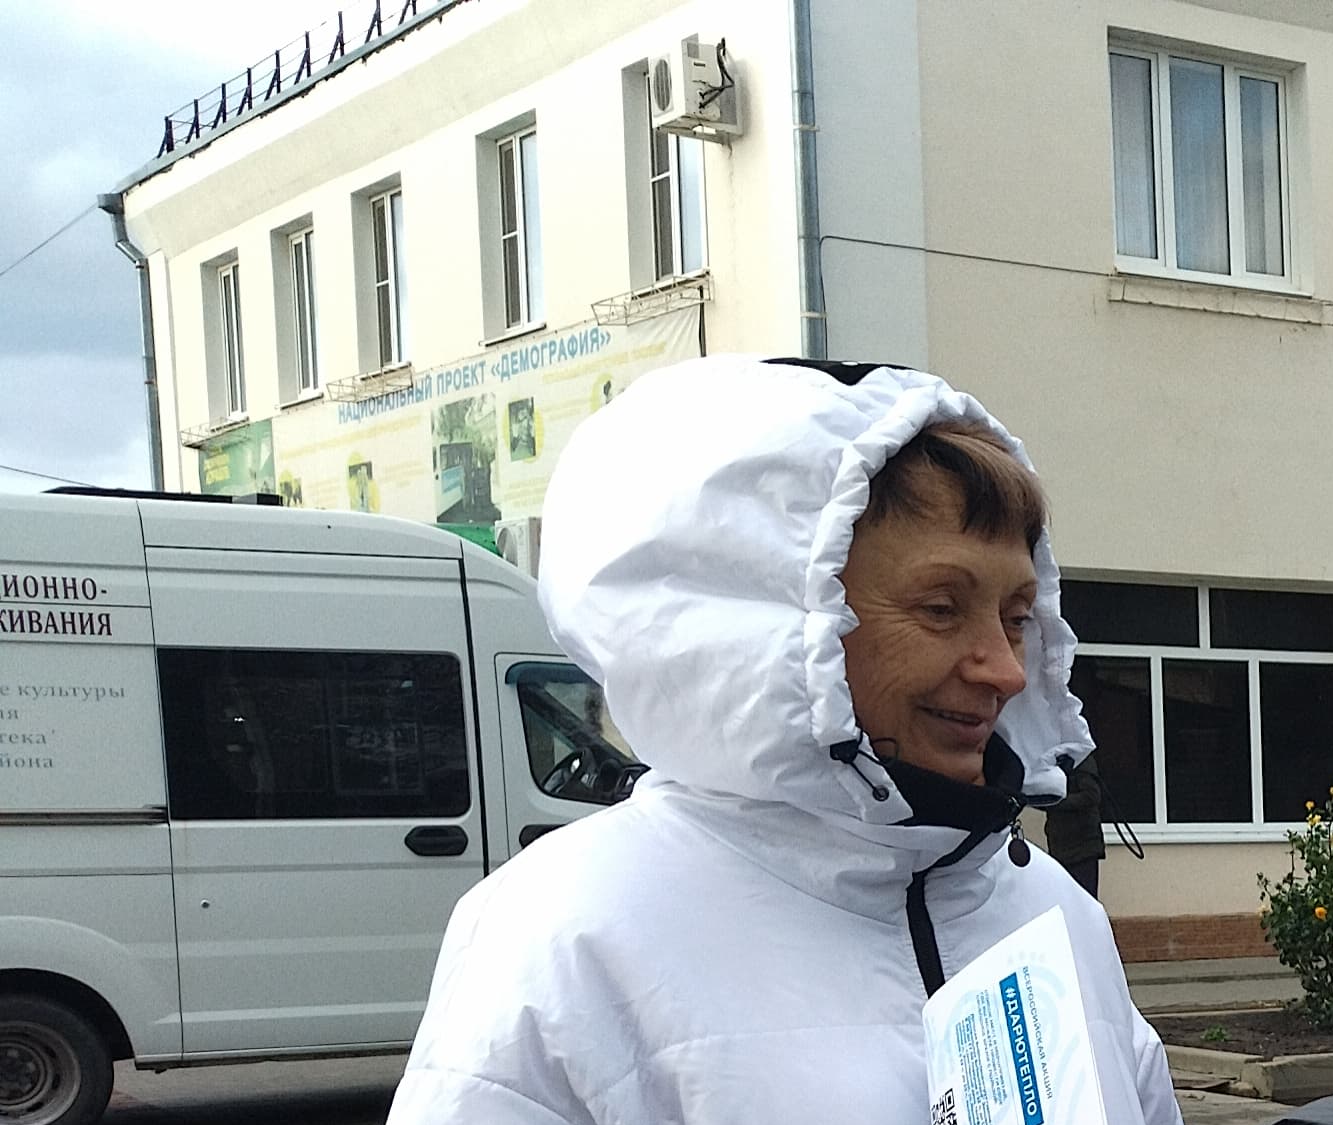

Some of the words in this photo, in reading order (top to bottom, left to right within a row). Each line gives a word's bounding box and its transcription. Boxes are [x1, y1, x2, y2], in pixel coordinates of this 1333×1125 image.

[338, 374, 432, 425] НАЦИОНАЛЬНЫЙ
[437, 360, 487, 399] ПРОЕКТ
[491, 326, 611, 383] «ДЕМОГРАФИЯ»
[0, 574, 107, 601] ИОННО-
[18, 685, 125, 702] культуры
[1004, 986, 1038, 1116] #ДАРЮТЕПЛО
[1022, 965, 1046, 1060] ВСЕРОССИЙСКАЯ
[1041, 1061, 1053, 1100] АКЦИЯ
